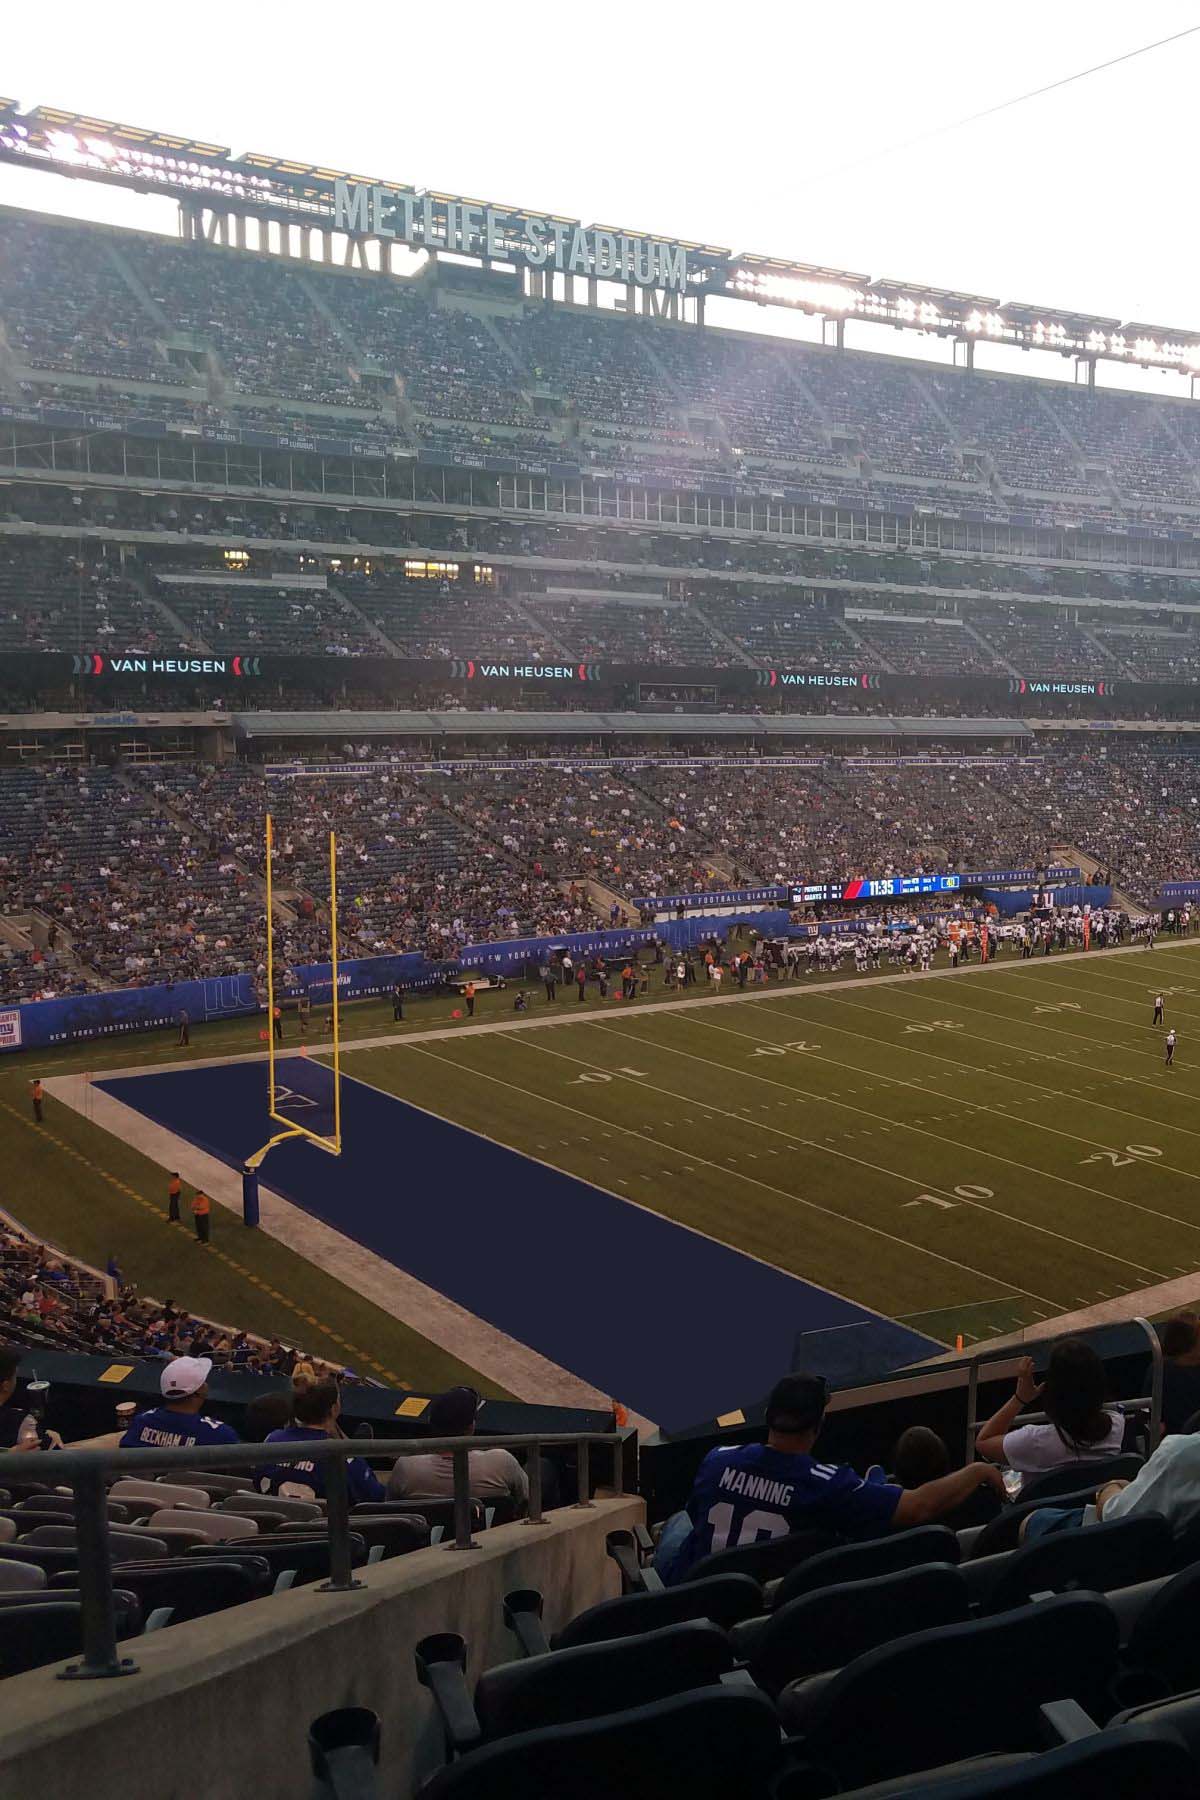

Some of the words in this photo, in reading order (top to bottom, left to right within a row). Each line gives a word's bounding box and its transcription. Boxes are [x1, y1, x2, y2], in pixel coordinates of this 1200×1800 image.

[334, 178, 509, 258] METLIFE
[524, 216, 686, 289] STADIUM
[111, 659, 147, 673] VAN
[152, 659, 226, 673] HEUSEN
[480, 666, 508, 678] VAN
[511, 666, 573, 679] HEUSEN
[781, 674, 805, 686] VAN
[808, 674, 857, 688] HEUSEN
[1029, 683, 1049, 694] VAN
[1052, 684, 1095, 694] HEUSEN
[869, 879, 894, 897] 11:35
[698, 894, 742, 905] FOOTBALL
[747, 890, 778, 900] GIANTS
[807, 925, 819, 936] ny
[831, 924, 849, 933] NEW
[49, 1032, 67, 1041] NEW
[72, 1029, 94, 1038] YORK
[98, 1021, 140, 1033] FOOTBALL
[753, 1040, 822, 1057] 20
[581, 1065, 649, 1084] 10
[1094, 1143, 1164, 1168] 20
[919, 1183, 995, 1210] 10
[140, 1427, 182, 1448] BECKHAM
[718, 1467, 795, 1507] MANNING
